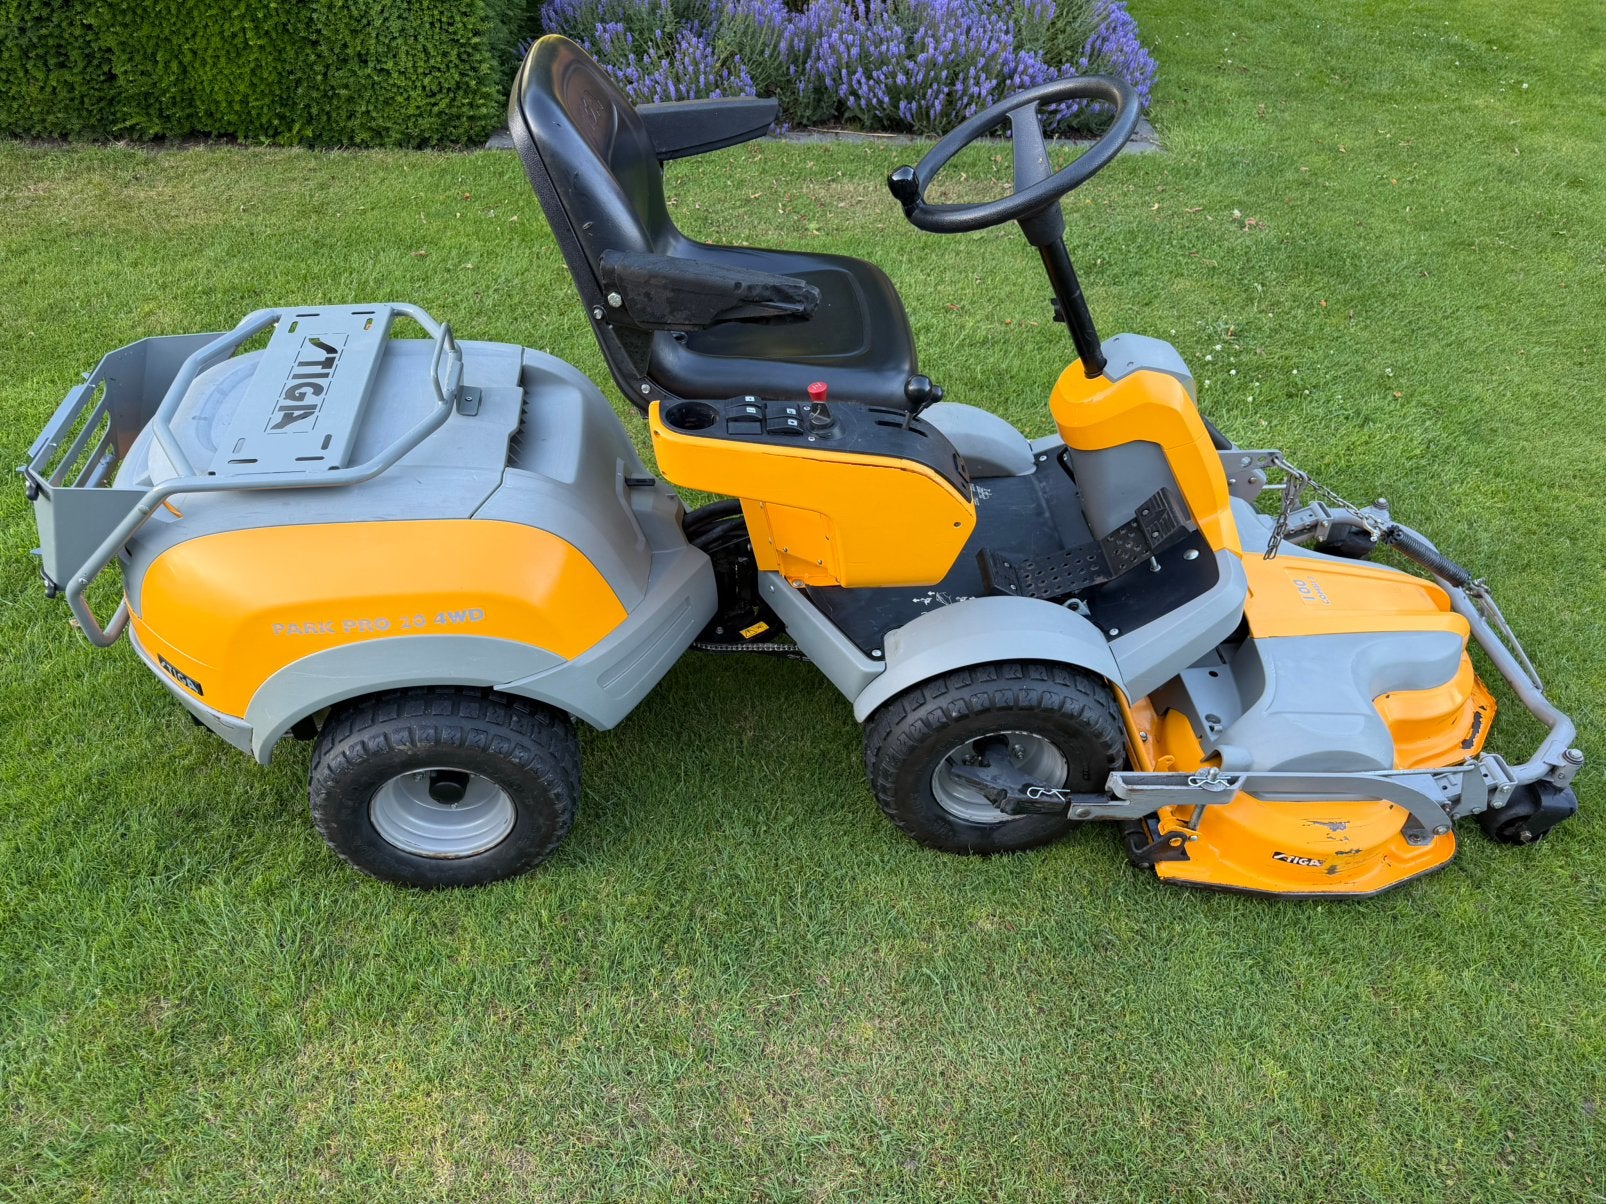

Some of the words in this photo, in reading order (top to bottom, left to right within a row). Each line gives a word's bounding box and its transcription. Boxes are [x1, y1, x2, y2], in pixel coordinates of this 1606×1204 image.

[270, 337, 339, 430] STIGA
[272, 621, 335, 636] PARK
[342, 617, 391, 633] PRO
[400, 614, 426, 629] 20
[434, 608, 485, 625] 4WD
[159, 659, 199, 694] STIGA
[1272, 853, 1323, 867] STIGA
